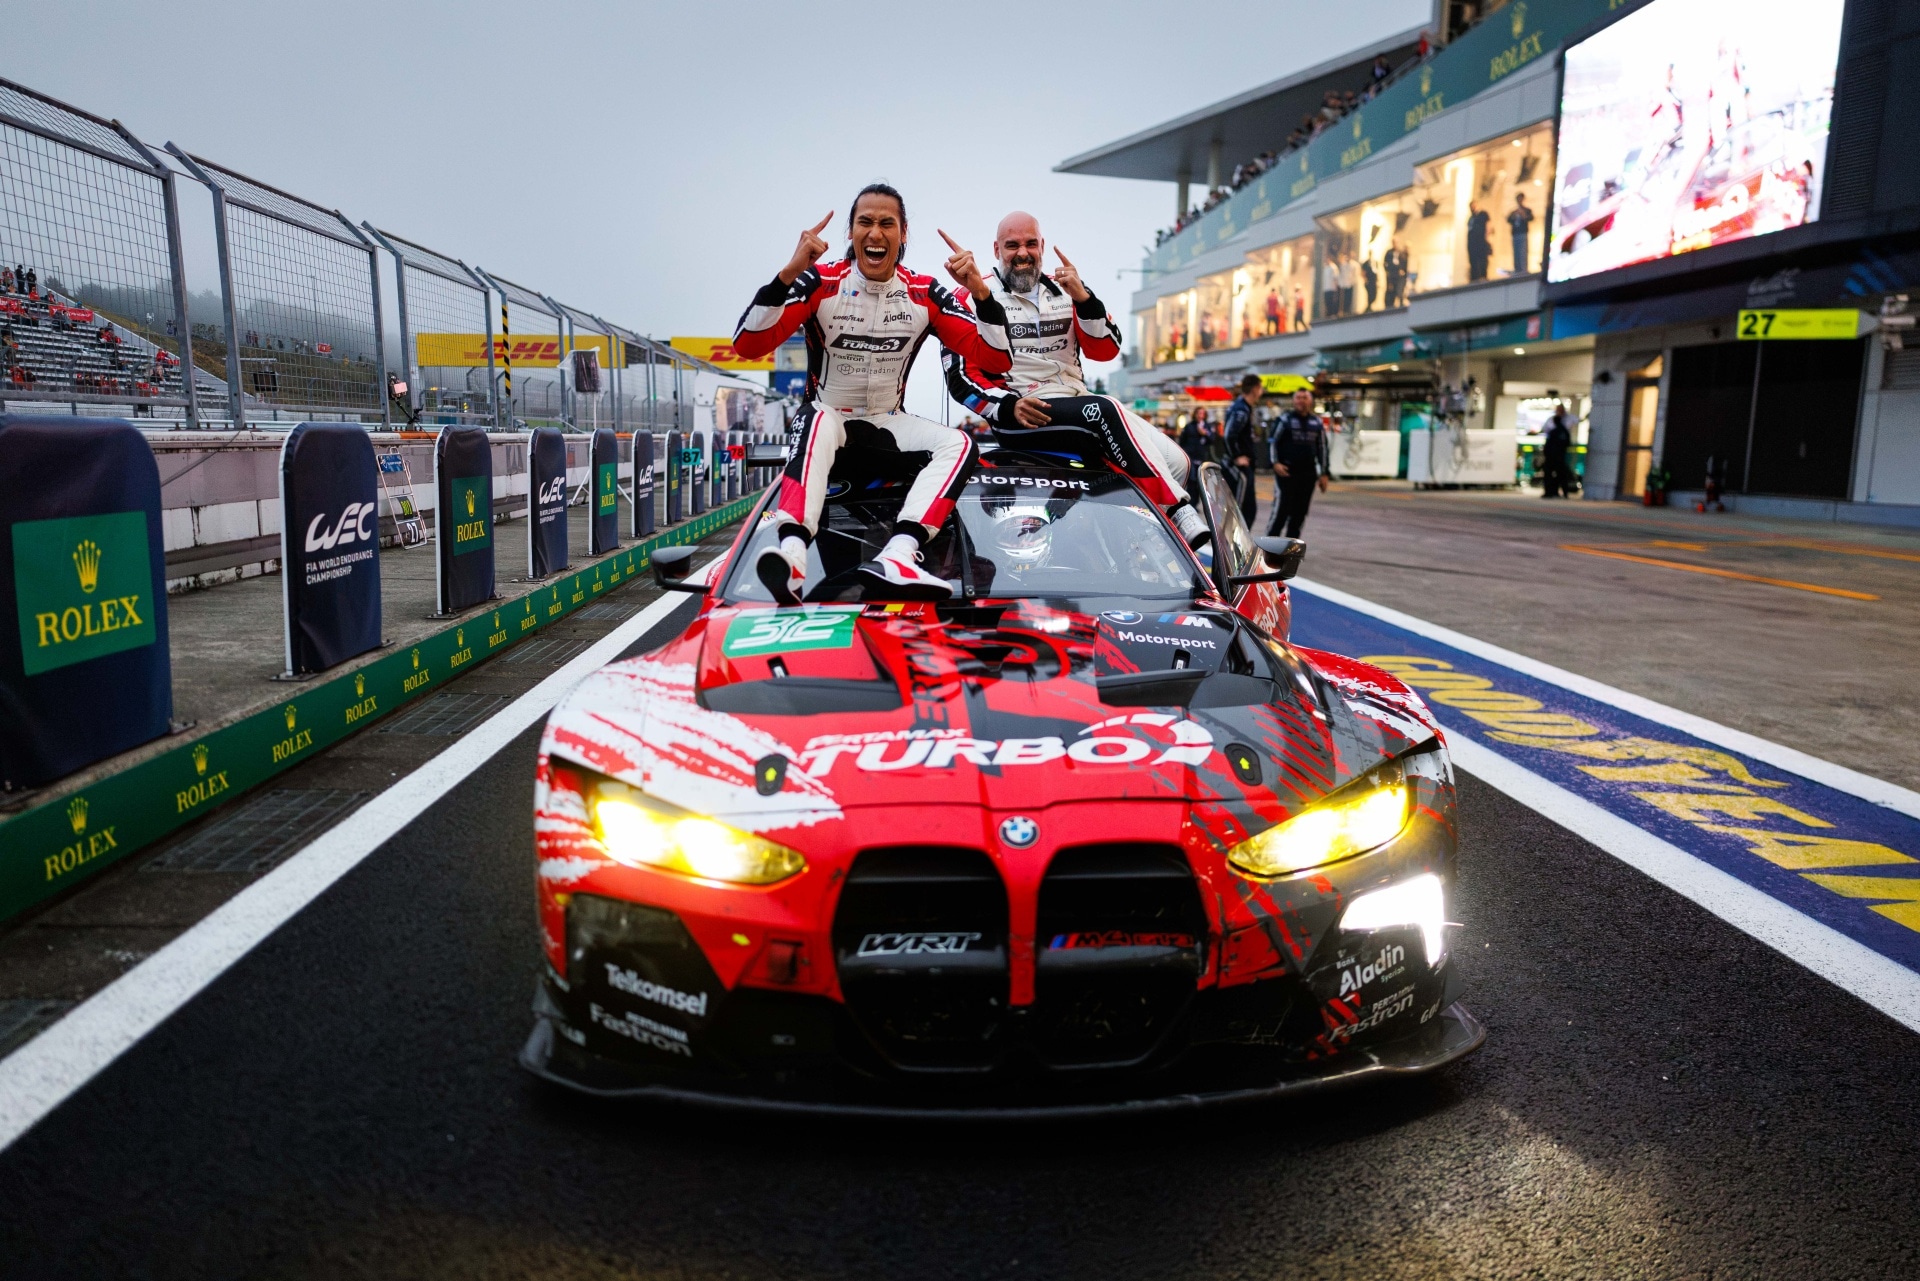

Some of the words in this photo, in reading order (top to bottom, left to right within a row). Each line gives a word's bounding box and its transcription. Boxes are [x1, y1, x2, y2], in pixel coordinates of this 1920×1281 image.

[1489, 30, 1544, 81] ROLEX
[886, 290, 908, 299] WEC
[833, 314, 865, 323] GOODYEAR
[883, 312, 912, 323] Aladin
[1742, 313, 1776, 336] 27
[1027, 323, 1064, 335] paradine
[479, 342, 560, 360] DHL
[842, 340, 890, 351] TURBO
[855, 367, 897, 375] paradine
[682, 451, 700, 463] 87
[723, 452, 730, 462] 7
[731, 447, 745, 458] 78
[639, 464, 654, 485] WEC
[965, 474, 1090, 491] otorsport
[539, 476, 566, 505] WEC
[601, 493, 615, 508] ROLEX
[305, 502, 375, 553] WEC
[406, 521, 420, 543] 27
[456, 520, 485, 543] ROLEX
[306, 562, 318, 574] FIA
[319, 557, 341, 570] WORLD
[341, 549, 374, 565] ENDURANCE
[306, 565, 353, 585] CHAMPIONSHIP
[572, 590, 584, 604] ROLEX
[549, 601, 563, 617] ROLEX
[35, 594, 144, 647] ROLEX
[521, 614, 537, 631] ROLEX
[488, 629, 507, 648] ROLEX
[729, 613, 851, 650] 32
[1118, 630, 1217, 649] Motorsport
[450, 647, 472, 668] ROLEX
[403, 668, 430, 693] ROLEX
[345, 695, 378, 725] ROLEX
[272, 728, 313, 763] ROLEX
[805, 728, 968, 750] PERTAMAX
[804, 736, 1152, 778] TURBO
[176, 770, 230, 813] ROLEX
[44, 825, 119, 881] ROLEX
[857, 931, 982, 957] WRT
[1336, 956, 1356, 970] Bank
[1339, 944, 1405, 997] Aladin
[603, 962, 708, 1017] Telkomsel
[1328, 993, 1414, 1042] Fastron
[589, 1002, 693, 1057] Fastron
